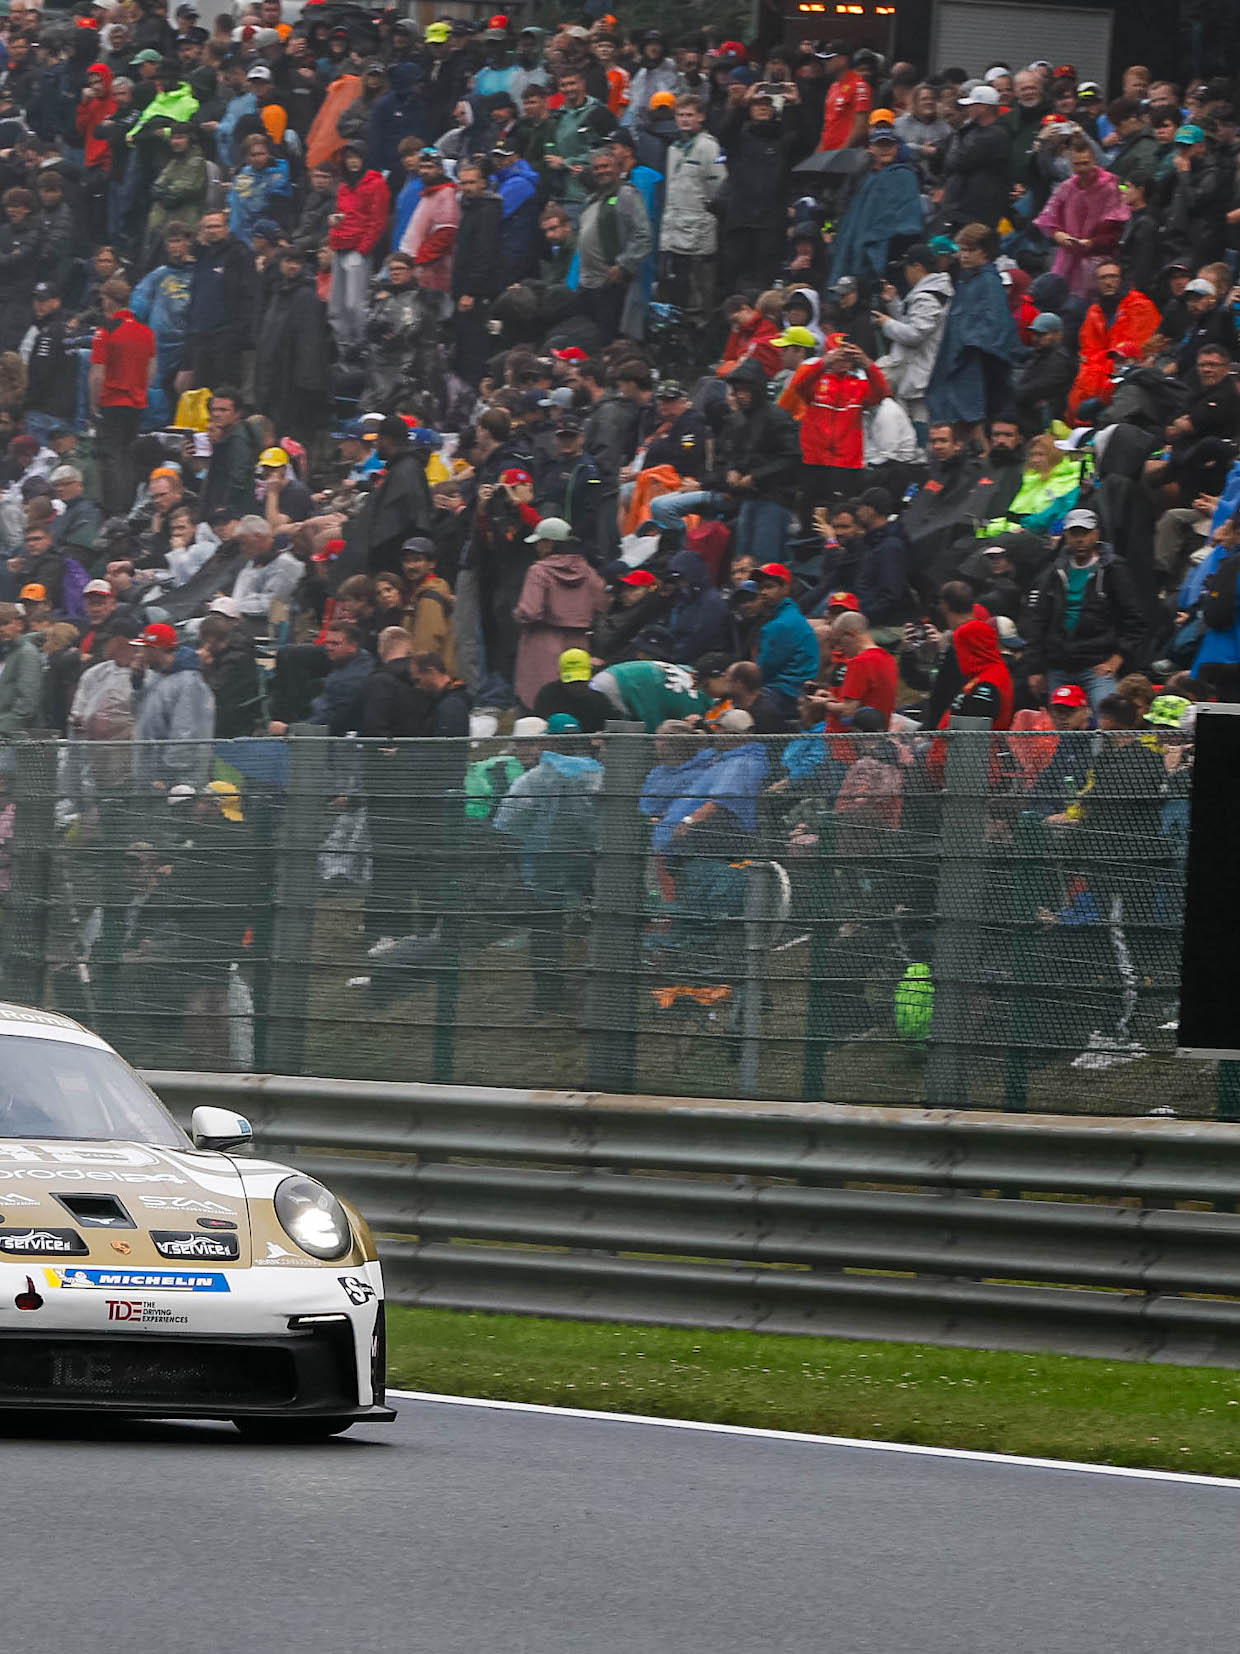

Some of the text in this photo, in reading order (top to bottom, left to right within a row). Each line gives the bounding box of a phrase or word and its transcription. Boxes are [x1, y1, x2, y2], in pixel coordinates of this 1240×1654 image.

[1, 1010, 78, 1029] Roma
[98, 1275, 214, 1287] MICHELIN
[104, 1300, 143, 1322] TDE
[143, 1301, 156, 1309] THE
[142, 1316, 189, 1324] EXPERIENCES
